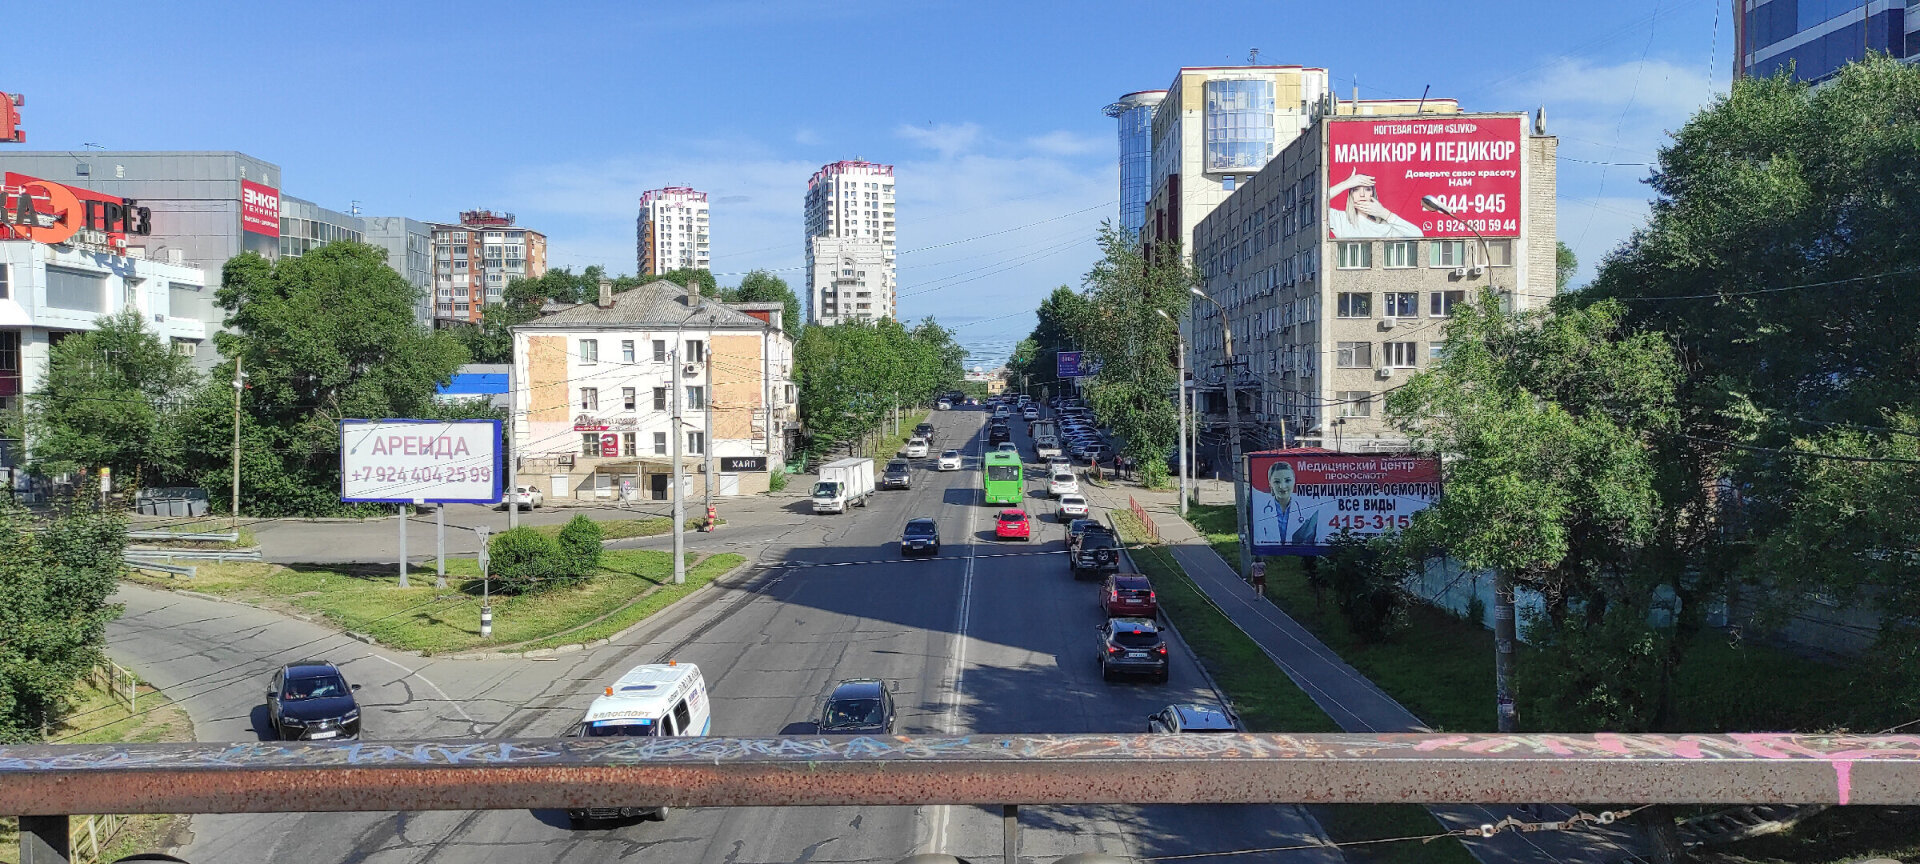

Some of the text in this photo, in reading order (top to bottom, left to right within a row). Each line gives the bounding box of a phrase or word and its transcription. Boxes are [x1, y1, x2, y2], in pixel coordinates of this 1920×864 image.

[1374, 124, 1412, 135] НОГТЕВАЯ
[1413, 124, 1443, 135] СТУДИЯ
[1335, 141, 1515, 163] МАНИКЮР И ПЕДИКЮР
[1405, 170, 1450, 179] Доверьте
[1478, 169, 1516, 178] красоту
[1448, 178, 1472, 186] НАМ
[243, 188, 278, 211] ЭНКА
[85, 197, 152, 236] ГРЁЗ
[1437, 220, 1444, 232] 8
[1446, 219, 1465, 232] 924
[1488, 219, 1501, 231] 59
[1503, 218, 1516, 231] 44
[371, 435, 470, 460] АРЕНДА
[731, 459, 756, 468] ХАЙП
[1297, 459, 1415, 473] Медицинский центр
[352, 466, 491, 483] +7 924 404 25 99
[1297, 480, 1440, 500] медицинские осмотры
[1338, 498, 1396, 513] все виды
[1328, 515, 1410, 530] 415-315
